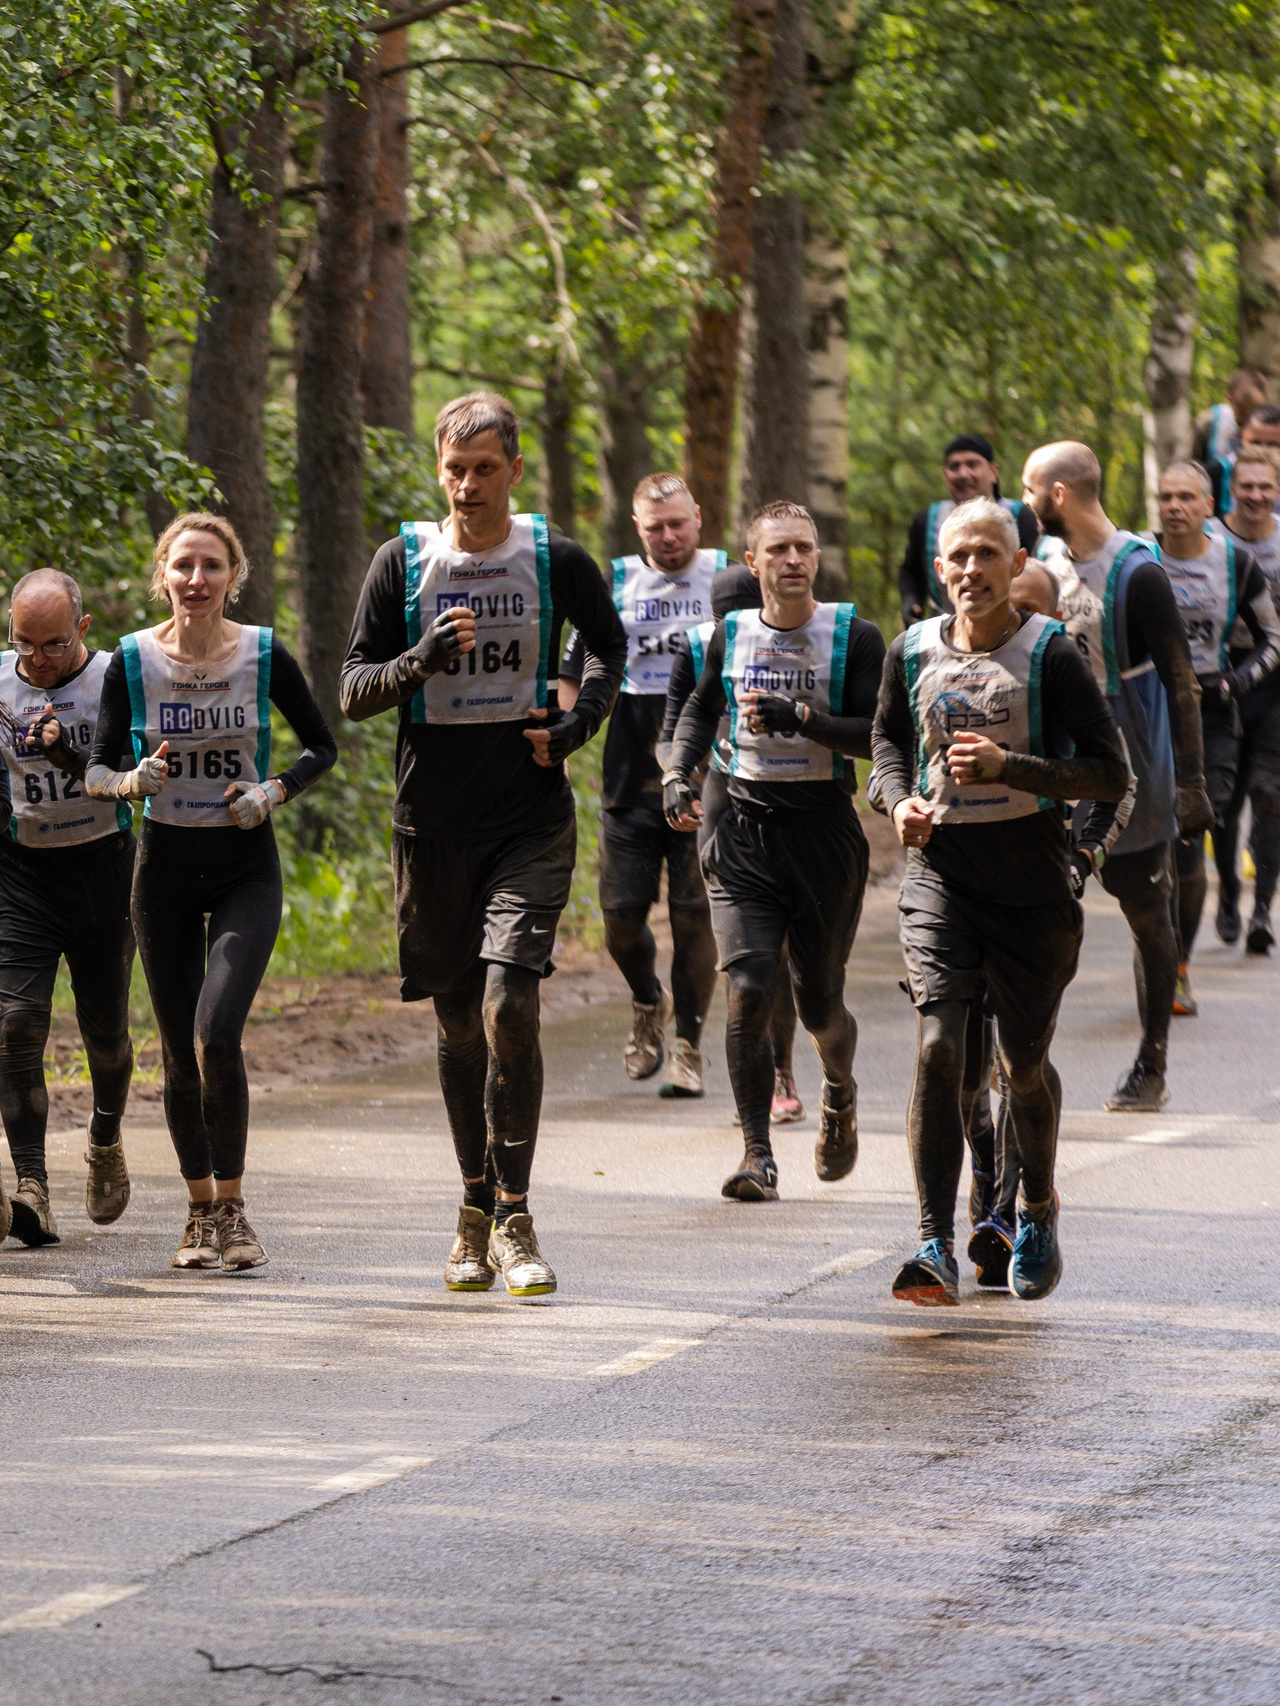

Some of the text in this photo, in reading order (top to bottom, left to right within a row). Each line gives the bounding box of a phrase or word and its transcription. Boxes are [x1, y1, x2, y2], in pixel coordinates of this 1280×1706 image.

[636, 600, 702, 620] RODVIG
[172, 681, 230, 690] ГОНКА ГЕРОЕВ
[162, 705, 245, 731] RODVIG
[166, 749, 242, 780] 5165
[53, 815, 96, 831] ГАЗПРОМБАНК
